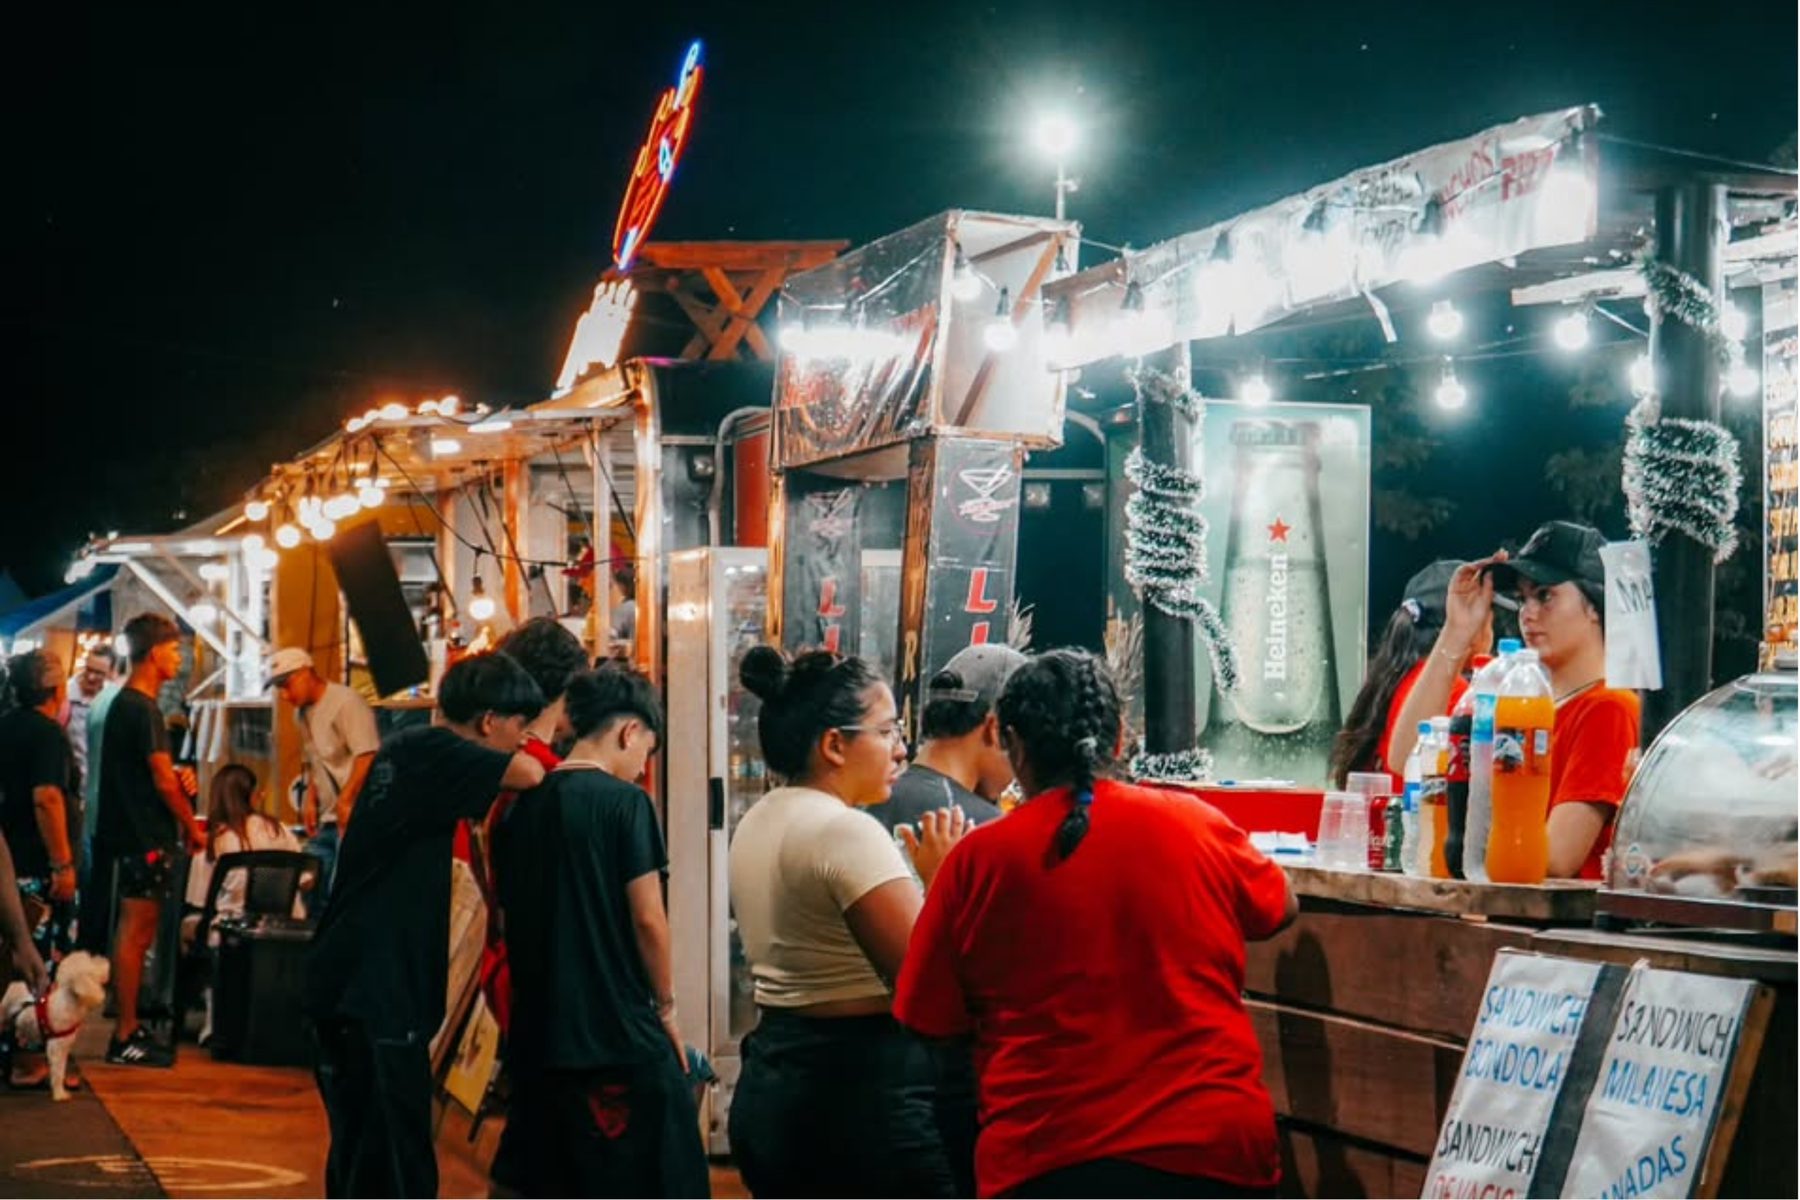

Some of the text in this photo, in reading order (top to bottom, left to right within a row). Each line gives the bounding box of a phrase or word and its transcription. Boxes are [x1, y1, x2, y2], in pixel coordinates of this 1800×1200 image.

[1264, 552, 1288, 681] Heineken
[1480, 985, 1587, 1036] SANDWICH
[1616, 1001, 1736, 1058] SANDWICH
[1465, 1040, 1566, 1092] BONDIOLA
[1602, 1058, 1708, 1118] MILANESA
[1438, 1119, 1541, 1175] SANDWICH
[1602, 1135, 1687, 1199] NADAS
